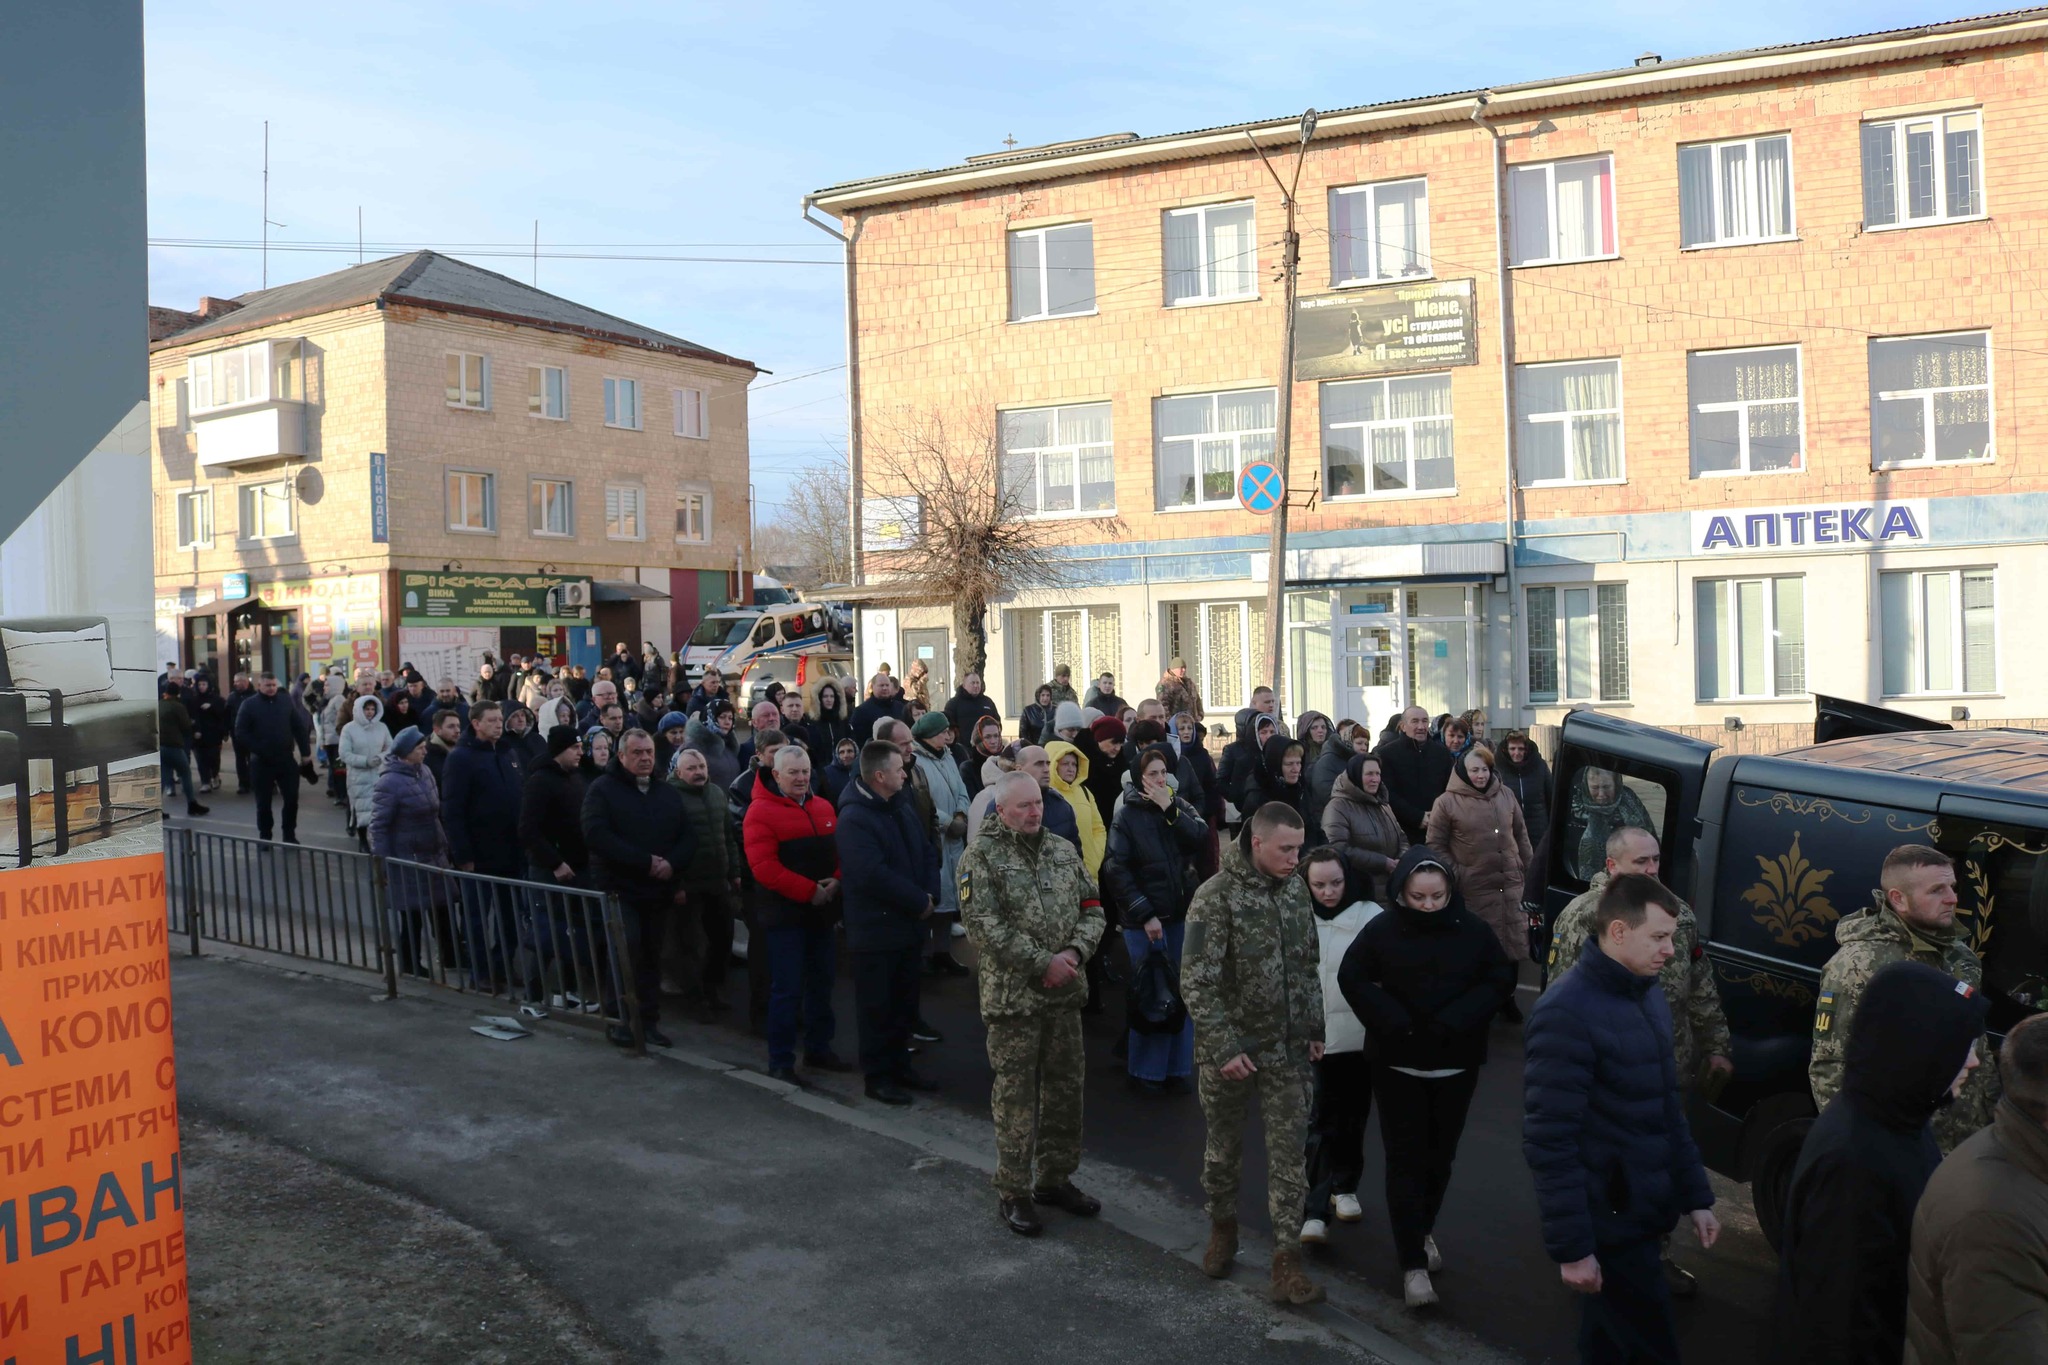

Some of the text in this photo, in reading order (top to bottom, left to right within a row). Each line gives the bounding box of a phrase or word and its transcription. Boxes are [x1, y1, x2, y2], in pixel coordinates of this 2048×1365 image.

[1300, 300, 1315, 309] Ісус
[1316, 297, 1347, 307] Христос
[1414, 300, 1463, 318] Мене,
[1382, 315, 1463, 336] усі струджені
[1403, 329, 1465, 345] та обтяжені,
[1375, 344, 1386, 360] Я
[1388, 349, 1407, 359] вас
[374, 455, 384, 536] ВІКНОДЕК
[1702, 505, 1923, 549] АПТЕКА
[263, 578, 375, 602] ВІКНОДЕК
[405, 574, 562, 590] ВІКНОДЕК
[428, 589, 455, 598] ВІКНА
[473, 598, 503, 606] ЗАХИСТНІ
[487, 591, 514, 599] ЖАЛЮЗІ
[465, 606, 536, 615] ПРОТИМОСКІТНА СІТКА
[874, 614, 885, 670] ОПТ
[20, 870, 165, 917] КІМНАТИ
[16, 917, 164, 969] КІМНАТИ
[43, 958, 165, 1002] ПРИХОЖІ
[41, 996, 173, 1057] КОМО
[66, 1102, 176, 1163] ДИТЯЧ
[60, 1230, 185, 1304] ГАРДЕ
